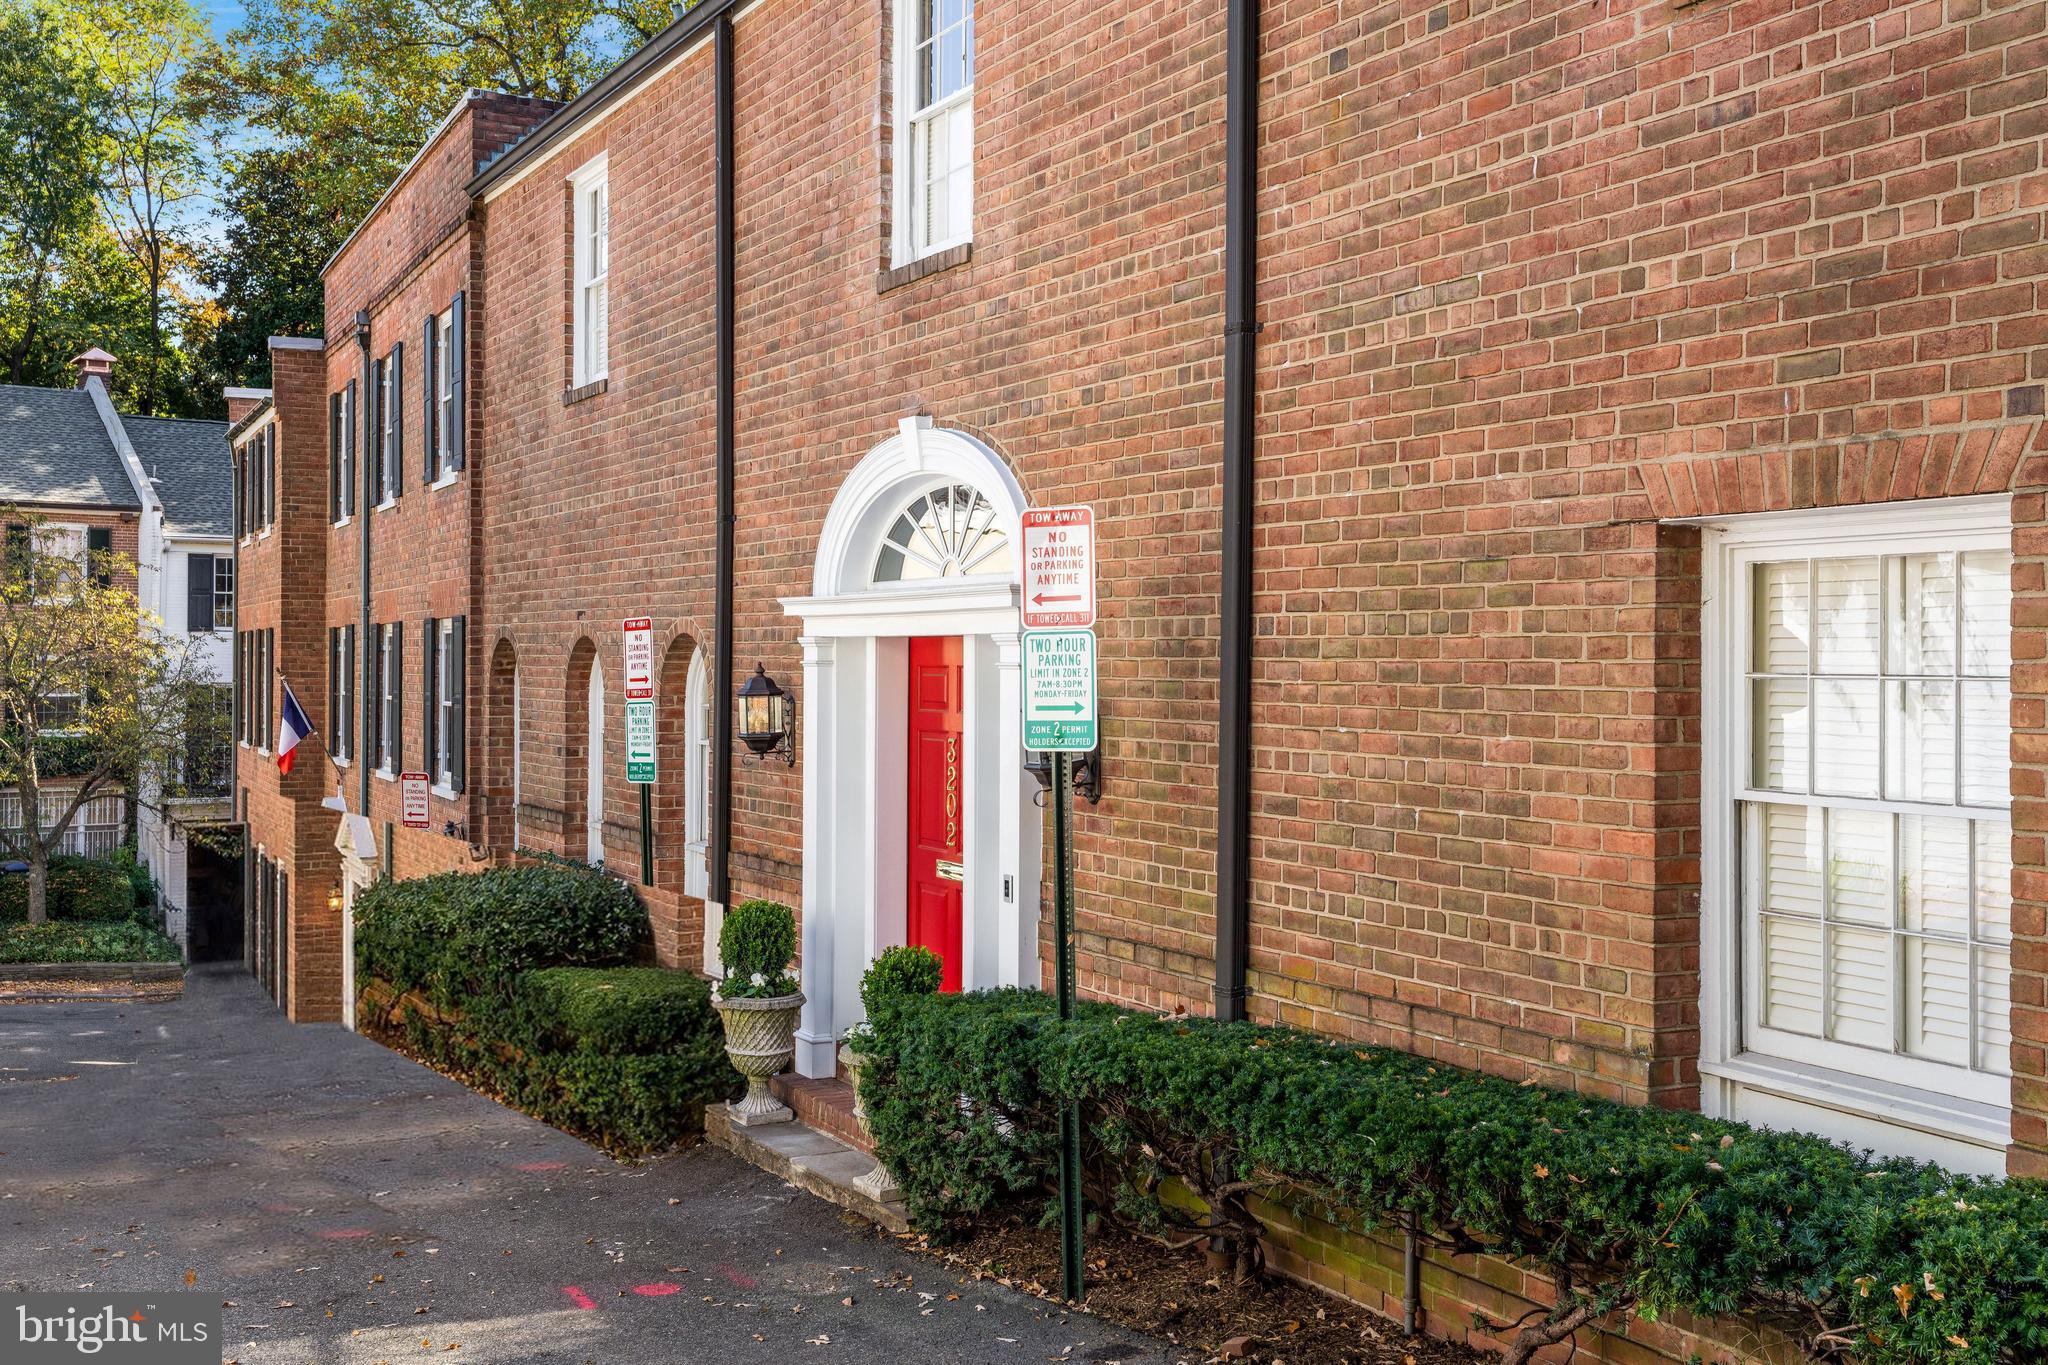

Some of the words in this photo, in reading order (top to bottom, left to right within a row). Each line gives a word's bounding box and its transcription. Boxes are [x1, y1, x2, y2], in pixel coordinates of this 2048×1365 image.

[1030, 513, 1051, 523] TOW
[1055, 512, 1084, 520] AWAY
[1048, 532, 1066, 542] NO
[1032, 546, 1084, 558] STANDING
[1031, 562, 1042, 571] OR
[1044, 560, 1084, 570] PARKING
[1037, 573, 1079, 585] ANYTIME
[1028, 615, 1034, 624] IF
[1036, 614, 1058, 624] TOWED
[1061, 614, 1077, 623] CALL
[1080, 613, 1089, 622] 311
[629, 644, 649, 652] STANDING
[1030, 639, 1051, 652] TWO
[1056, 638, 1086, 652] HOUR
[1038, 654, 1081, 666] PARKING
[631, 662, 647, 670] ANYTIME
[1030, 669, 1050, 678] LIMIT
[1052, 668, 1060, 678] IN
[1063, 668, 1081, 678] ZONE
[1084, 668, 1088, 677] 2
[1034, 690, 1087, 698] MONDAY-FRIDAY
[629, 707, 637, 716] TWO
[1031, 726, 1050, 734] ZONE
[1054, 721, 1060, 736] 2
[946, 738, 957, 846] 3202
